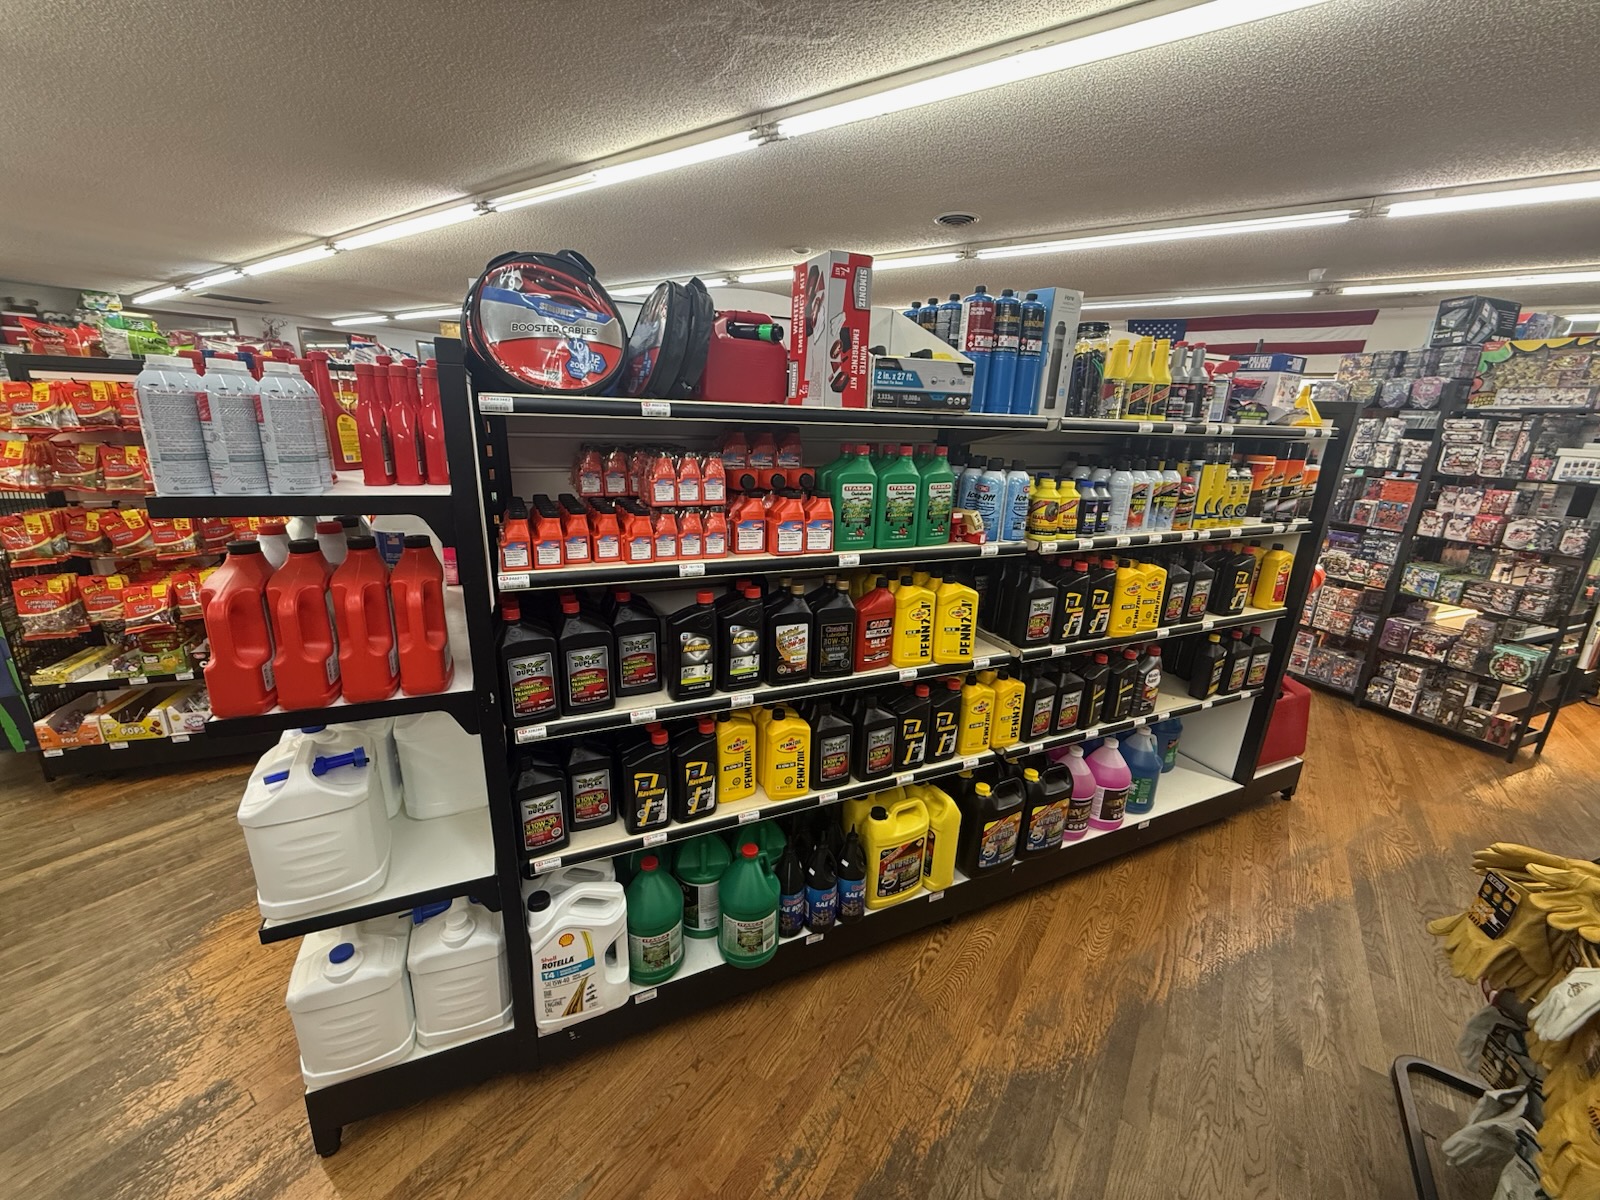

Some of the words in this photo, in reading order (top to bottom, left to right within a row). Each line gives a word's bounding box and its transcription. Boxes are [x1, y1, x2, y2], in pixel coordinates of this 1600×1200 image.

[859, 269, 868, 308] SIMONIZ
[511, 323, 560, 333] BOOSTER
[560, 325, 598, 336] CABLES
[851, 329, 860, 375] EMERGENCY
[859, 345, 867, 375] WINTER
[569, 361, 585, 370] 200
[877, 371, 882, 380] 2
[883, 371, 891, 380] in.
[897, 373, 905, 381] 27
[733, 636, 758, 645] Havoline
[625, 644, 649, 652] DUPLEX
[683, 643, 711, 653] Havoline
[574, 659, 600, 668] DUPLEX
[516, 666, 544, 676] DUPLEX
[514, 683, 541, 692] AUTOMATIC
[572, 678, 605, 687] TRANSMISSION
[515, 686, 550, 696] TRANSMISSION
[120, 727, 146, 735] POPS
[61, 736, 79, 744] POPS
[727, 739, 748, 750] PENNZOIL
[780, 740, 801, 749] PENNZOIL
[744, 750, 752, 789] PENNZOIL
[796, 750, 805, 789] PENNZOIL
[578, 781, 602, 789] DUPLEX
[688, 775, 714, 786] Havoline
[637, 788, 666, 798] Havoline
[528, 804, 554, 815] DUPLEX
[541, 955, 557, 963] Shell
[542, 956, 574, 970] ROTELLA
[552, 977, 570, 986] 15W-40
[545, 1000, 562, 1008] ENGINE
